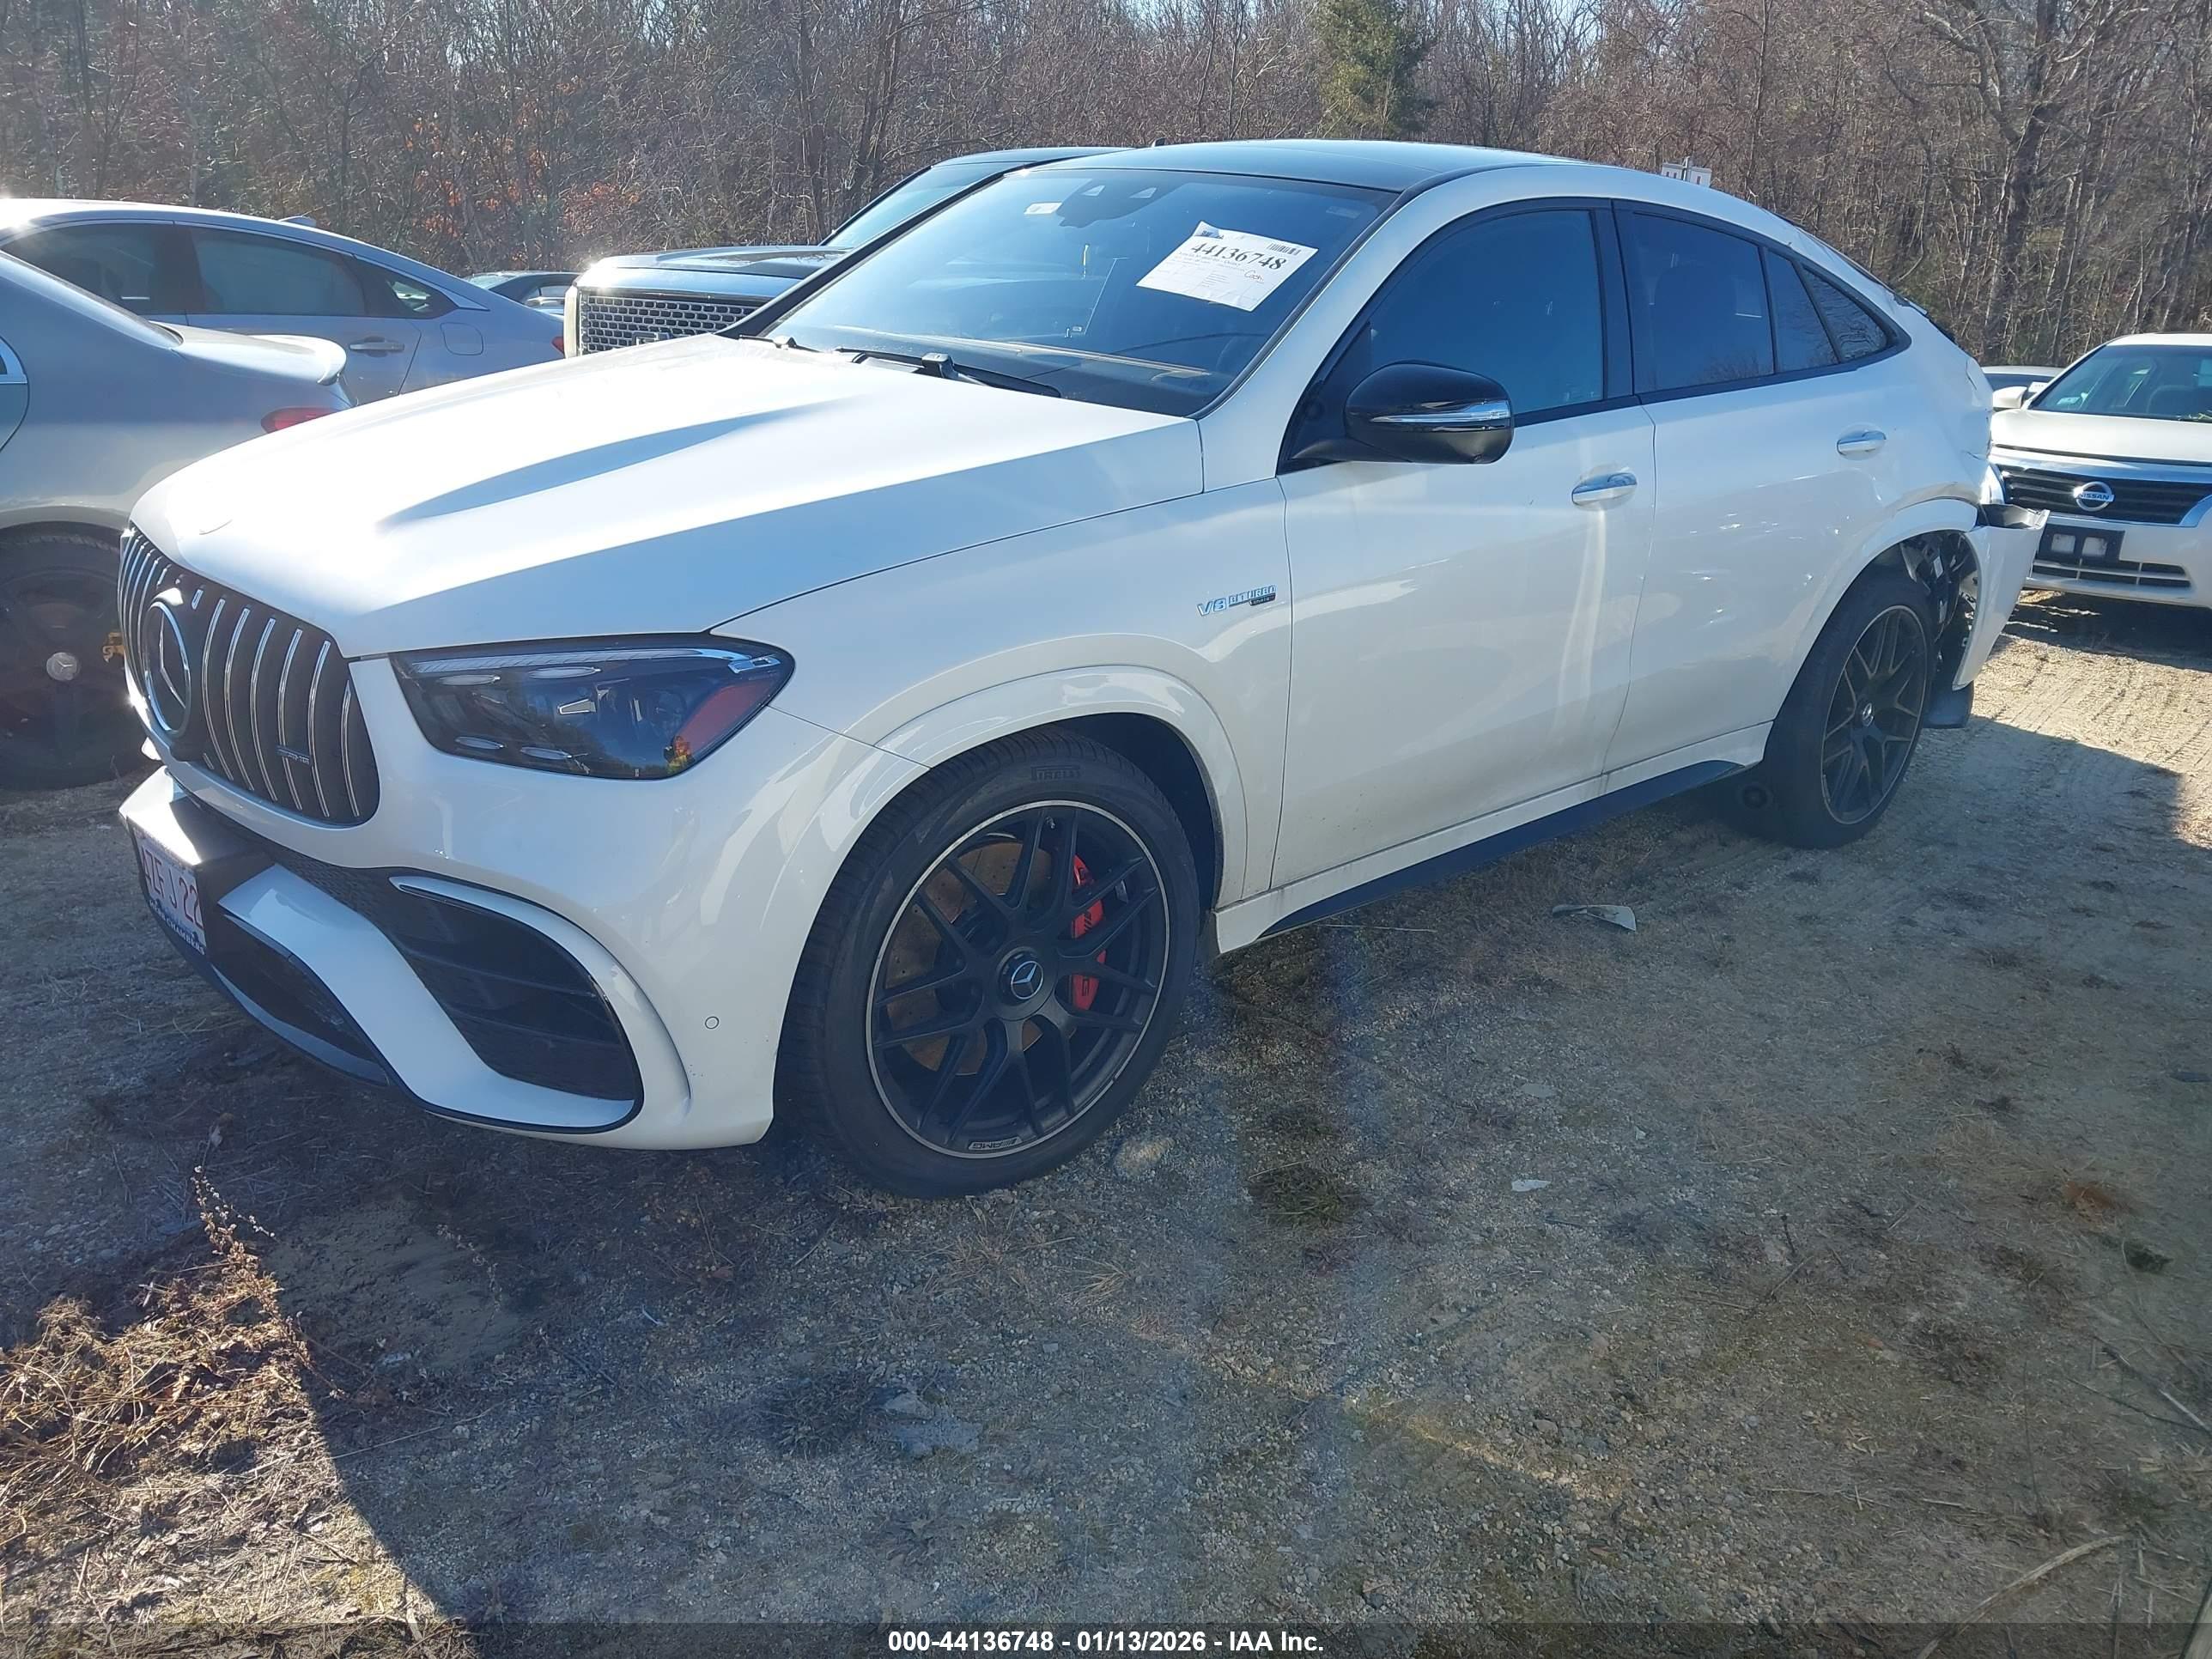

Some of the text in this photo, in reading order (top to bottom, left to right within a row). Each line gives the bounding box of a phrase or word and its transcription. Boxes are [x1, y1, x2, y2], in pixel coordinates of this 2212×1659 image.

[1191, 242, 1287, 270] 44136748
[1197, 596, 1226, 617] V8
[1228, 585, 1277, 605] BITURBO
